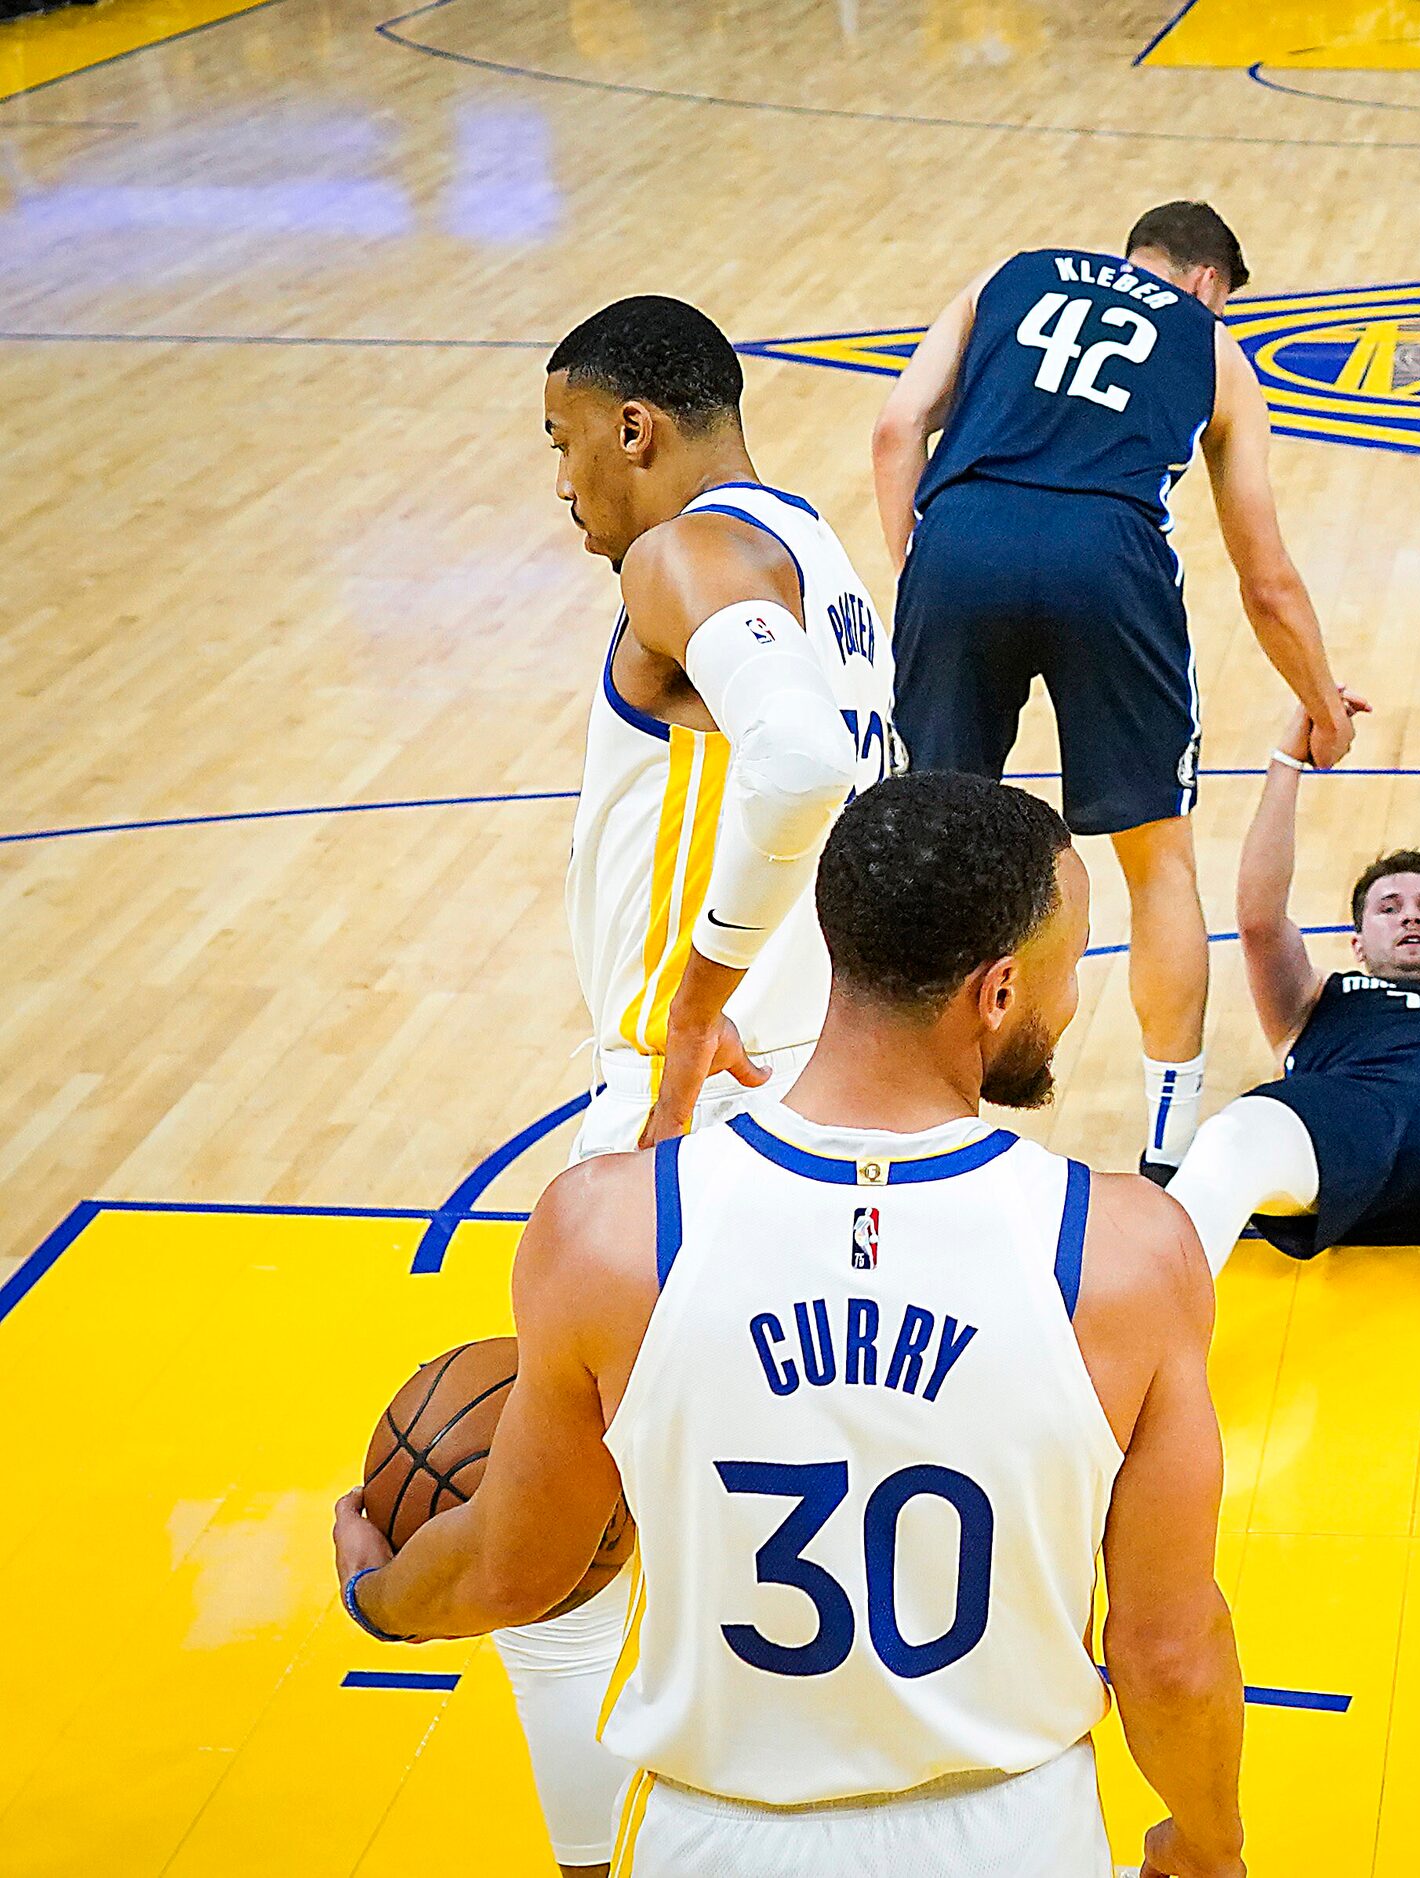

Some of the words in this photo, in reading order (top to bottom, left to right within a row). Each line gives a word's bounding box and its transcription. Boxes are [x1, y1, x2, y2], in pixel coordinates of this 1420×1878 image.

[1054, 257, 1179, 310] KLEBER
[1016, 292, 1158, 413] 42
[749, 1298, 978, 1402] CURRY
[712, 1459, 995, 1679] 30
